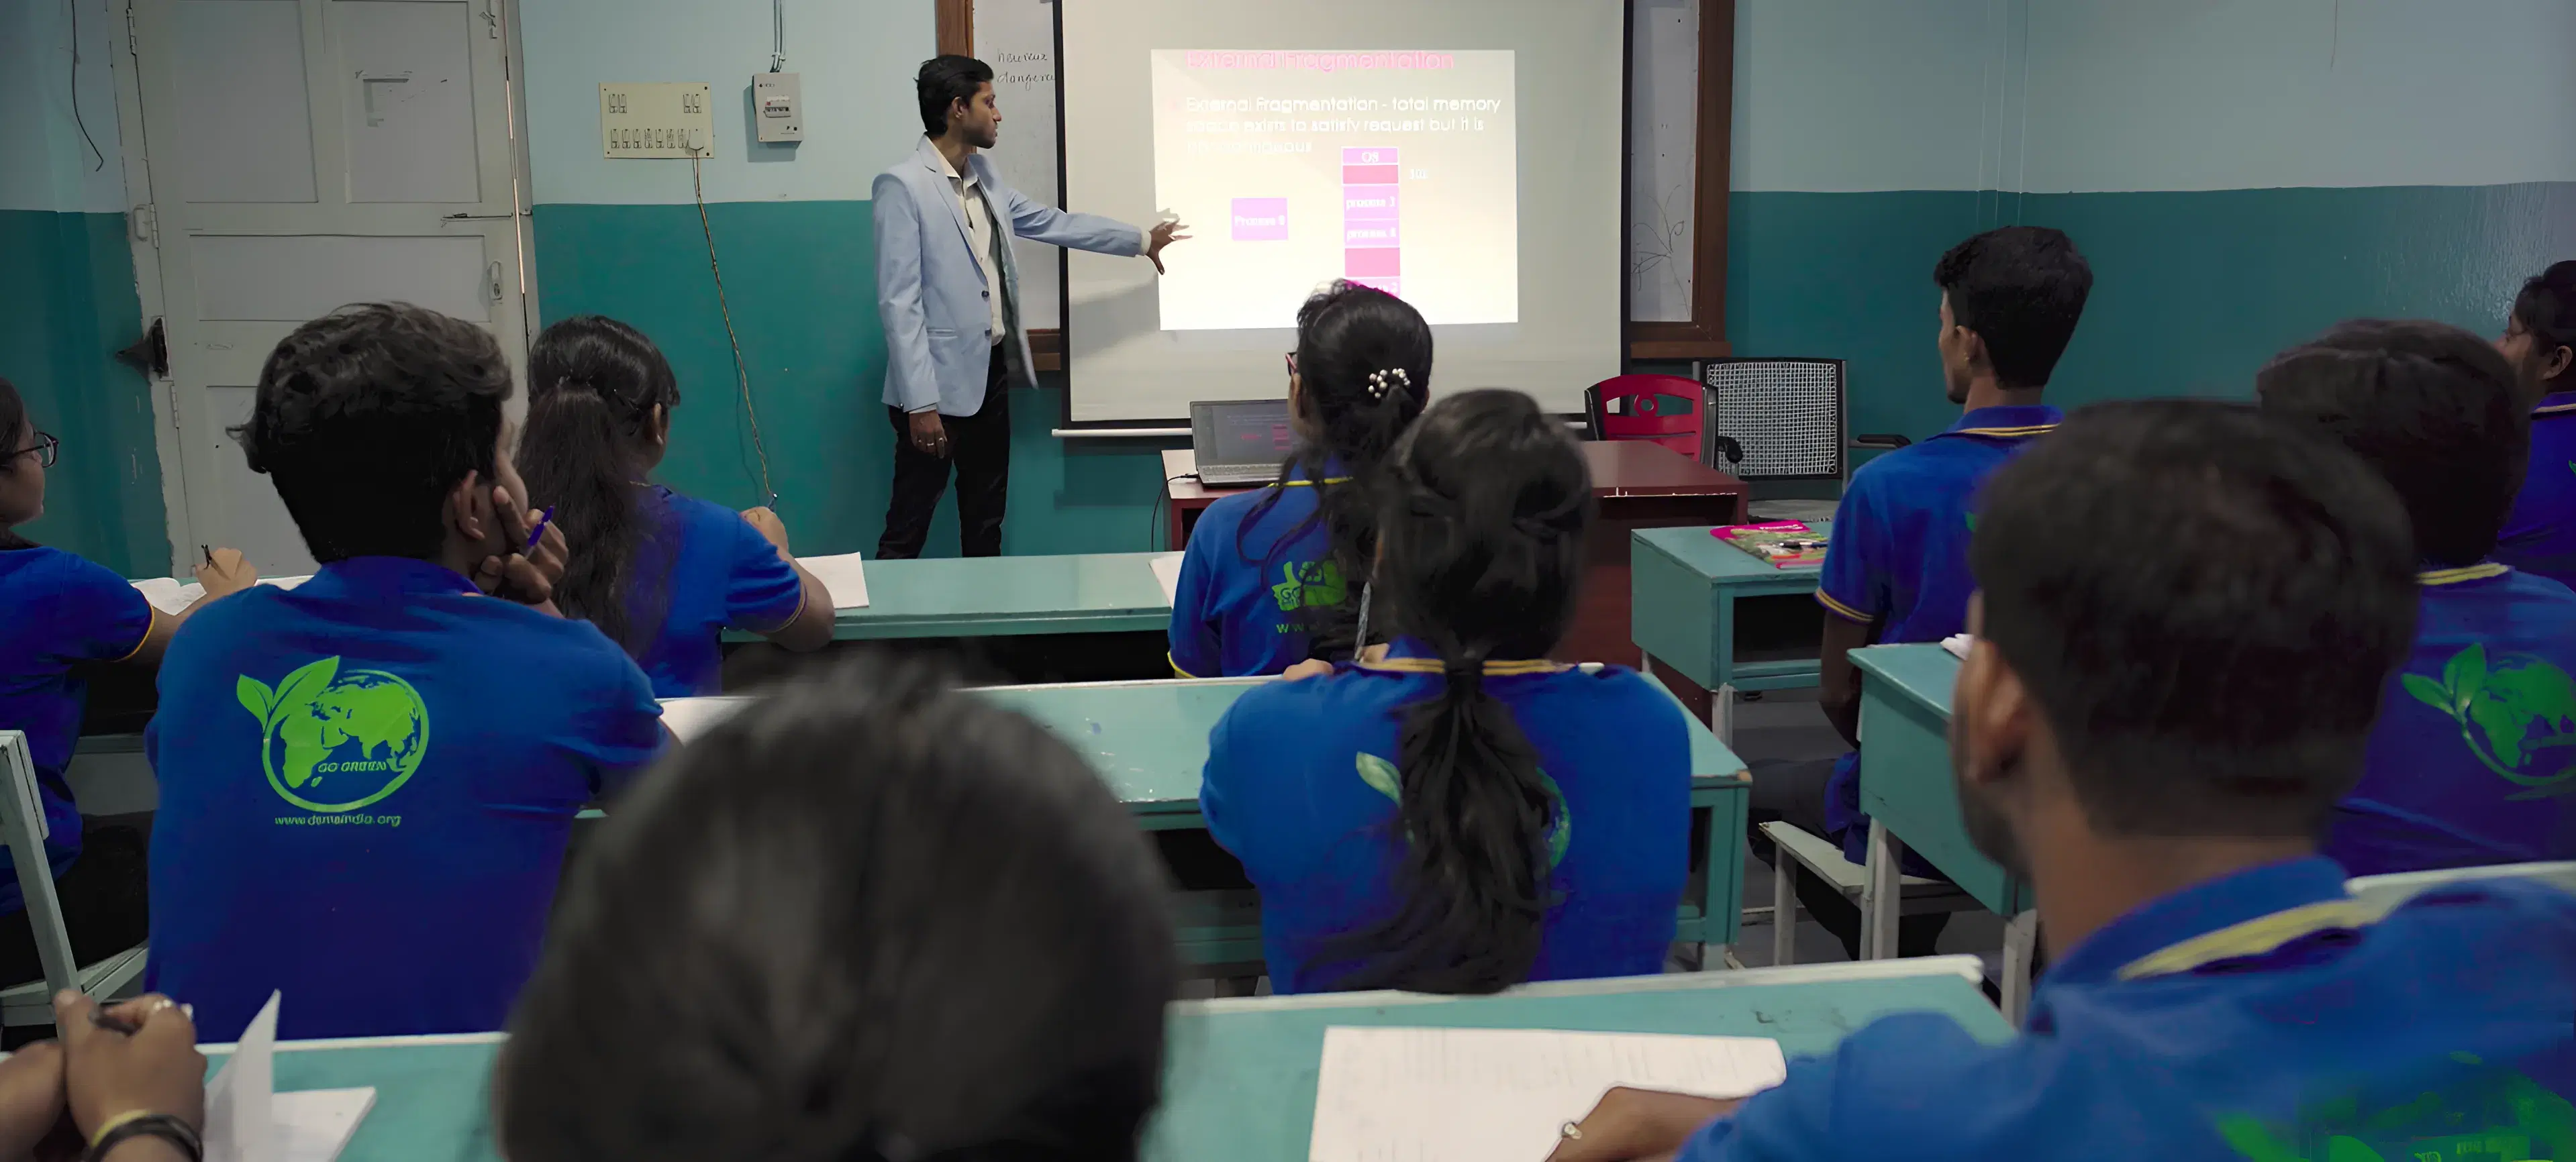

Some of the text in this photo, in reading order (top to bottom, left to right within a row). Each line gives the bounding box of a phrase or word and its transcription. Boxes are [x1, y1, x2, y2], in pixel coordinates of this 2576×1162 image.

[1185, 51, 1454, 73] External Fragmentation
[1392, 97, 1428, 111] total
[1434, 99, 1501, 113] memory
[1291, 118, 1307, 132] to
[1365, 119, 1424, 134] request
[1430, 118, 1455, 131] but
[317, 761, 387, 773] GO GREEN
